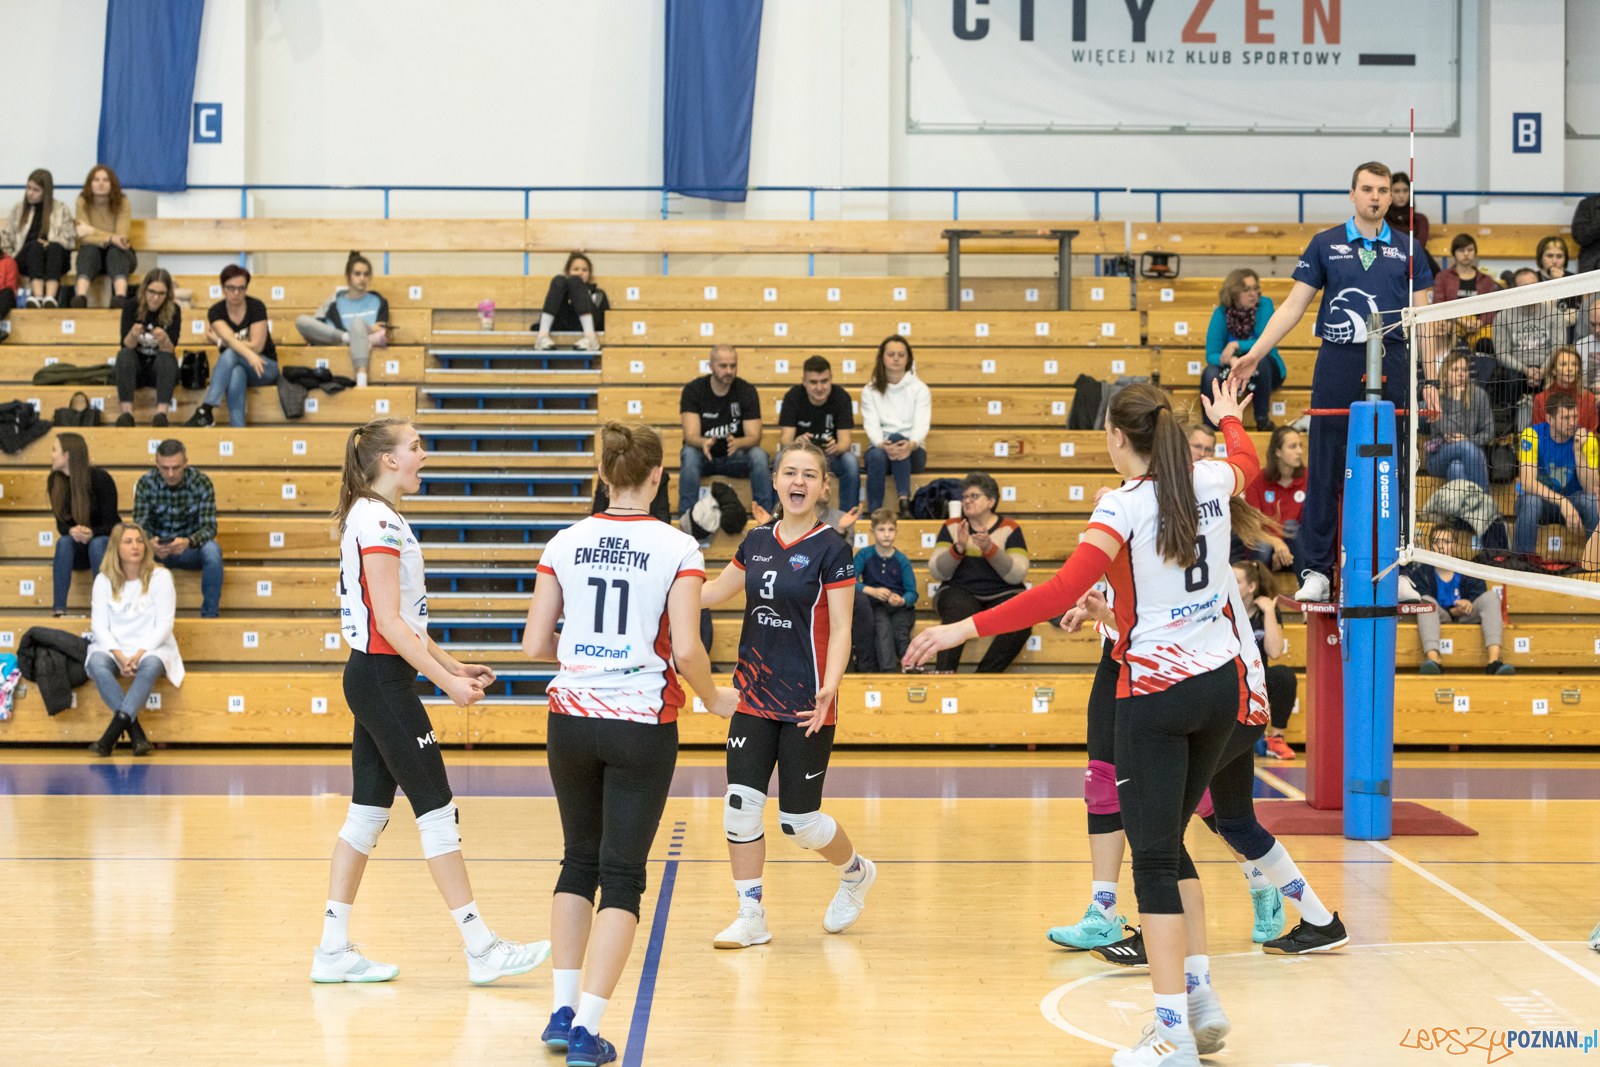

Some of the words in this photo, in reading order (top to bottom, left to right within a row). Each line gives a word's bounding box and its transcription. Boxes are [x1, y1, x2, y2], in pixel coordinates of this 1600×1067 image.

[1071, 49, 1136, 66] WIĘCEJ
[1146, 48, 1175, 64] NIŻ
[1186, 50, 1232, 65] KLUB
[1242, 50, 1341, 65] SPORTOWY
[200, 109, 216, 137] C
[1518, 119, 1536, 147] B
[1380, 474, 1390, 518] Senoh
[598, 536, 630, 550] ENEA
[574, 547, 650, 571] ENERGETYK
[760, 570, 778, 600] 3
[587, 577, 630, 635] 11
[1307, 604, 1335, 613] Senoh
[1410, 604, 1433, 613] Senoh
[757, 612, 792, 629] Enea
[2, 634, 11, 642] 13
[247, 634, 255, 642] 10
[330, 636, 336, 644] 9
[1441, 641, 1450, 649] 14
[1518, 640, 1527, 648] 13
[150, 696, 158, 704] 11
[870, 693, 876, 702] 5
[232, 698, 241, 707] 10
[316, 700, 322, 708] 9
[947, 700, 952, 708] 4
[1457, 699, 1466, 707] 14
[1536, 701, 1545, 710] 13
